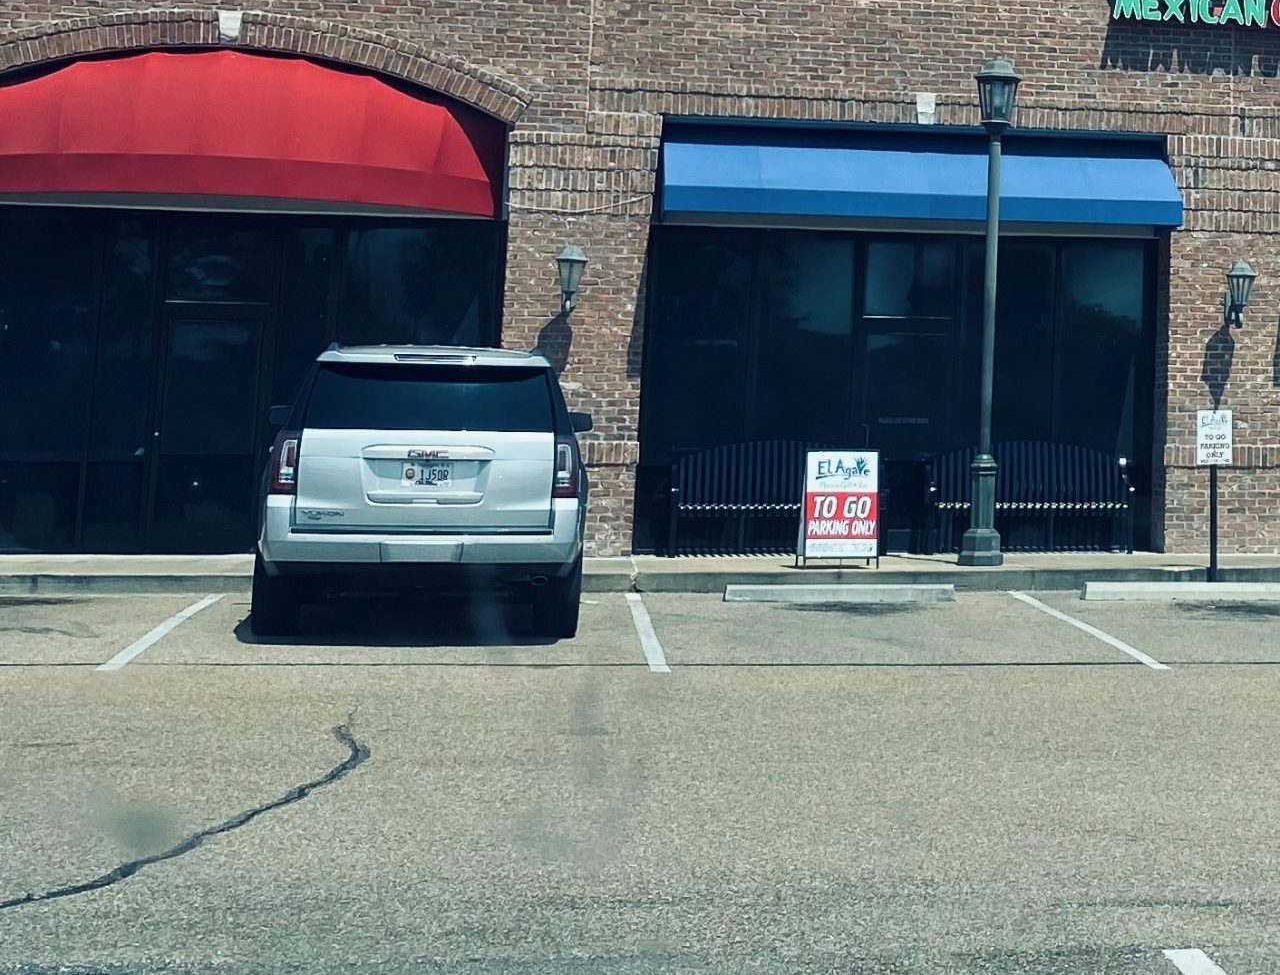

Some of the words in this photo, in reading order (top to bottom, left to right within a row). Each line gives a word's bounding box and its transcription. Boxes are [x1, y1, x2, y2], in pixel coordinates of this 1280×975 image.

[407, 449, 450, 459] GMC
[818, 459, 832, 475] El
[835, 456, 871, 480] Agave
[812, 495, 838, 519] TO
[842, 495, 872, 519] GO
[807, 519, 850, 536] PARKING
[851, 519, 877, 536] ONLY
